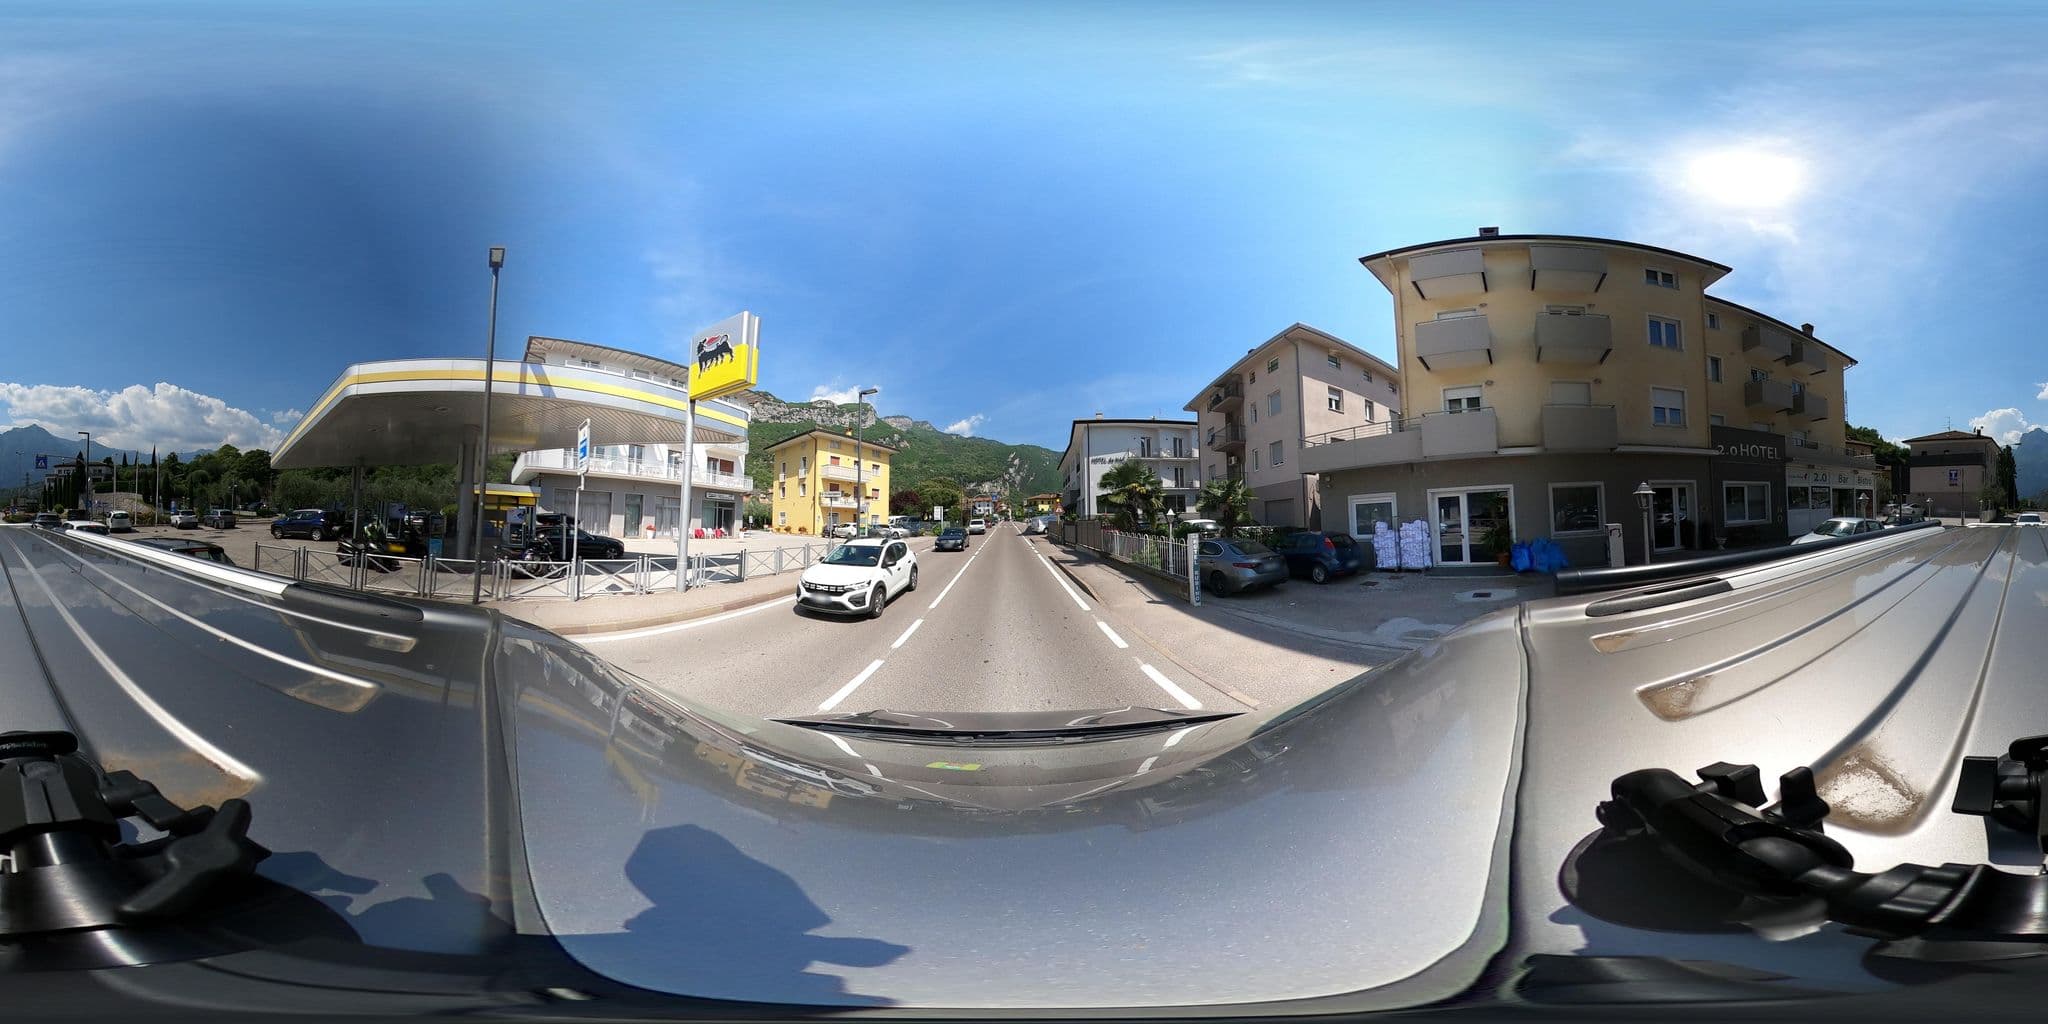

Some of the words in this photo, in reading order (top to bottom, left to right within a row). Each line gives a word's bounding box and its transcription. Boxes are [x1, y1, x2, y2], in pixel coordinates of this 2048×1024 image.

[1740, 443, 1780, 459] HOTEL
[1813, 472, 1827, 482] 2.0
[1839, 474, 1848, 483] Bar
